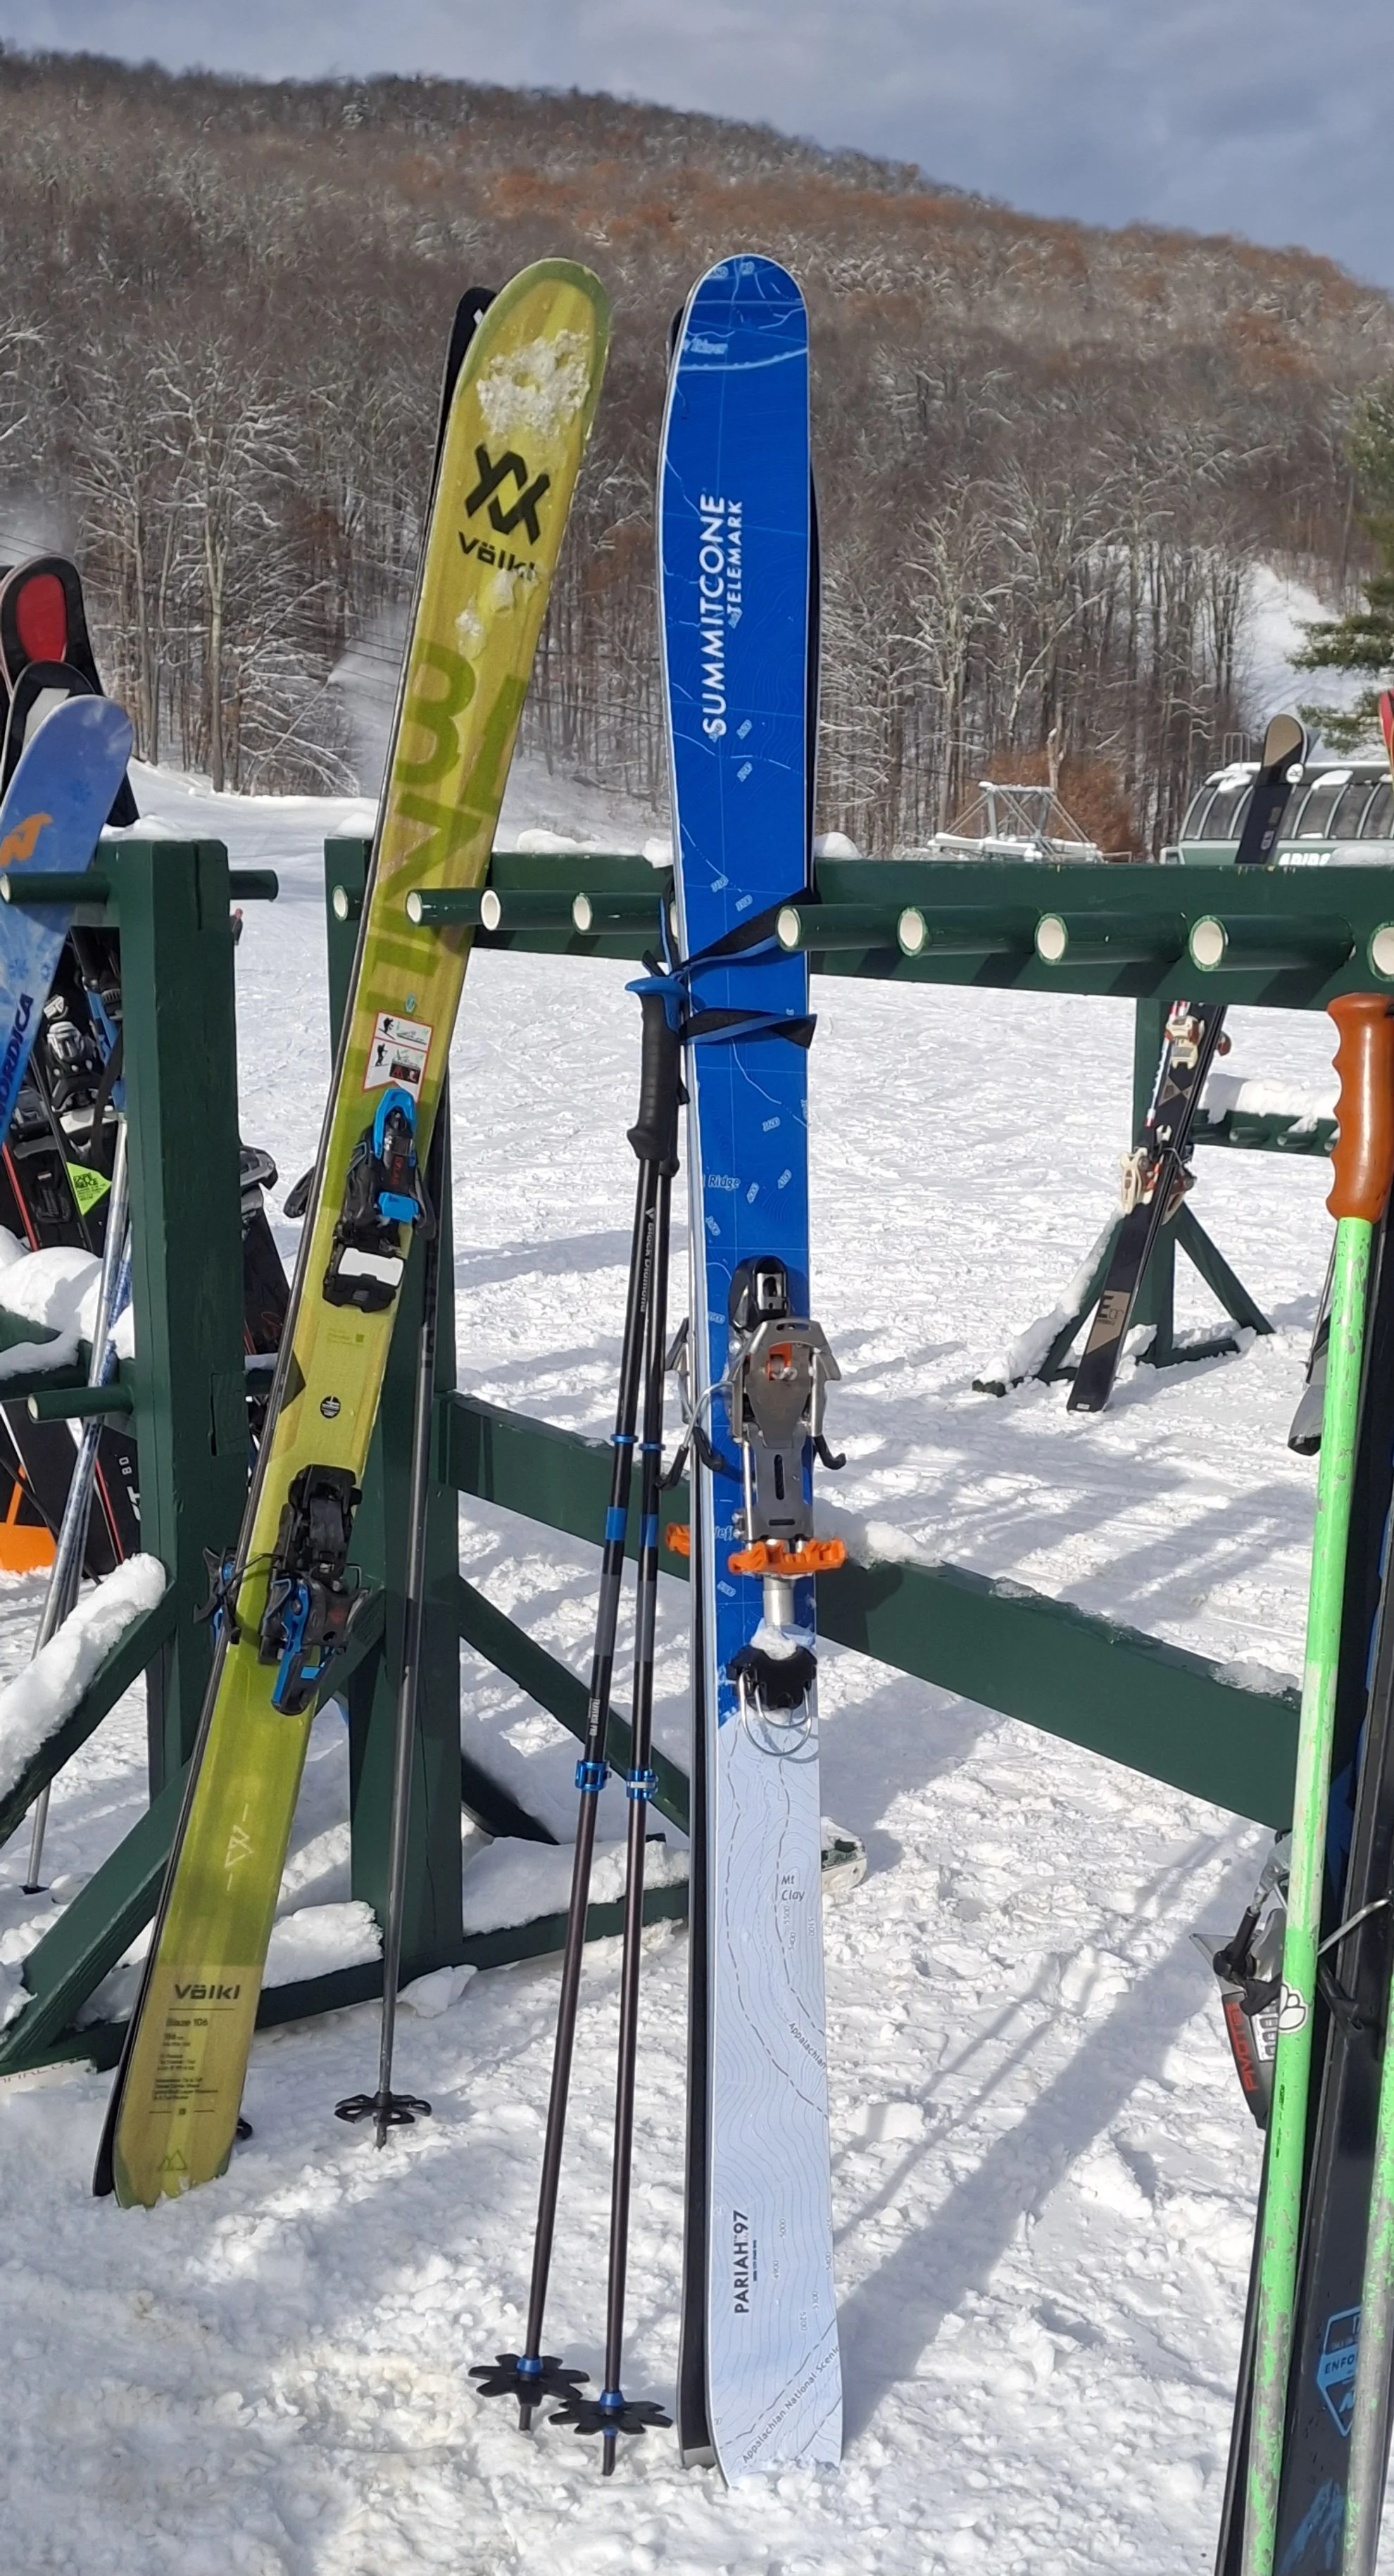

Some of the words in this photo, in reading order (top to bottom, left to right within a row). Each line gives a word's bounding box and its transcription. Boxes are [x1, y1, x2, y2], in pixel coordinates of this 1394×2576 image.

[727, 500, 743, 614] TELEMARK
[699, 494, 727, 736] SUMMITCONE
[709, 1175, 741, 1190] Ridge
[781, 1875, 794, 1885] Mt
[781, 1890, 805, 1902] Clay
[174, 1984, 241, 2000] Völkl
[789, 2023, 827, 2069] Appalachian
[733, 2210, 749, 2234] 97
[1325, 2354, 1355, 2375] ENFO
[743, 2410, 786, 2463] Appalachian
[785, 2372, 817, 2410] National
